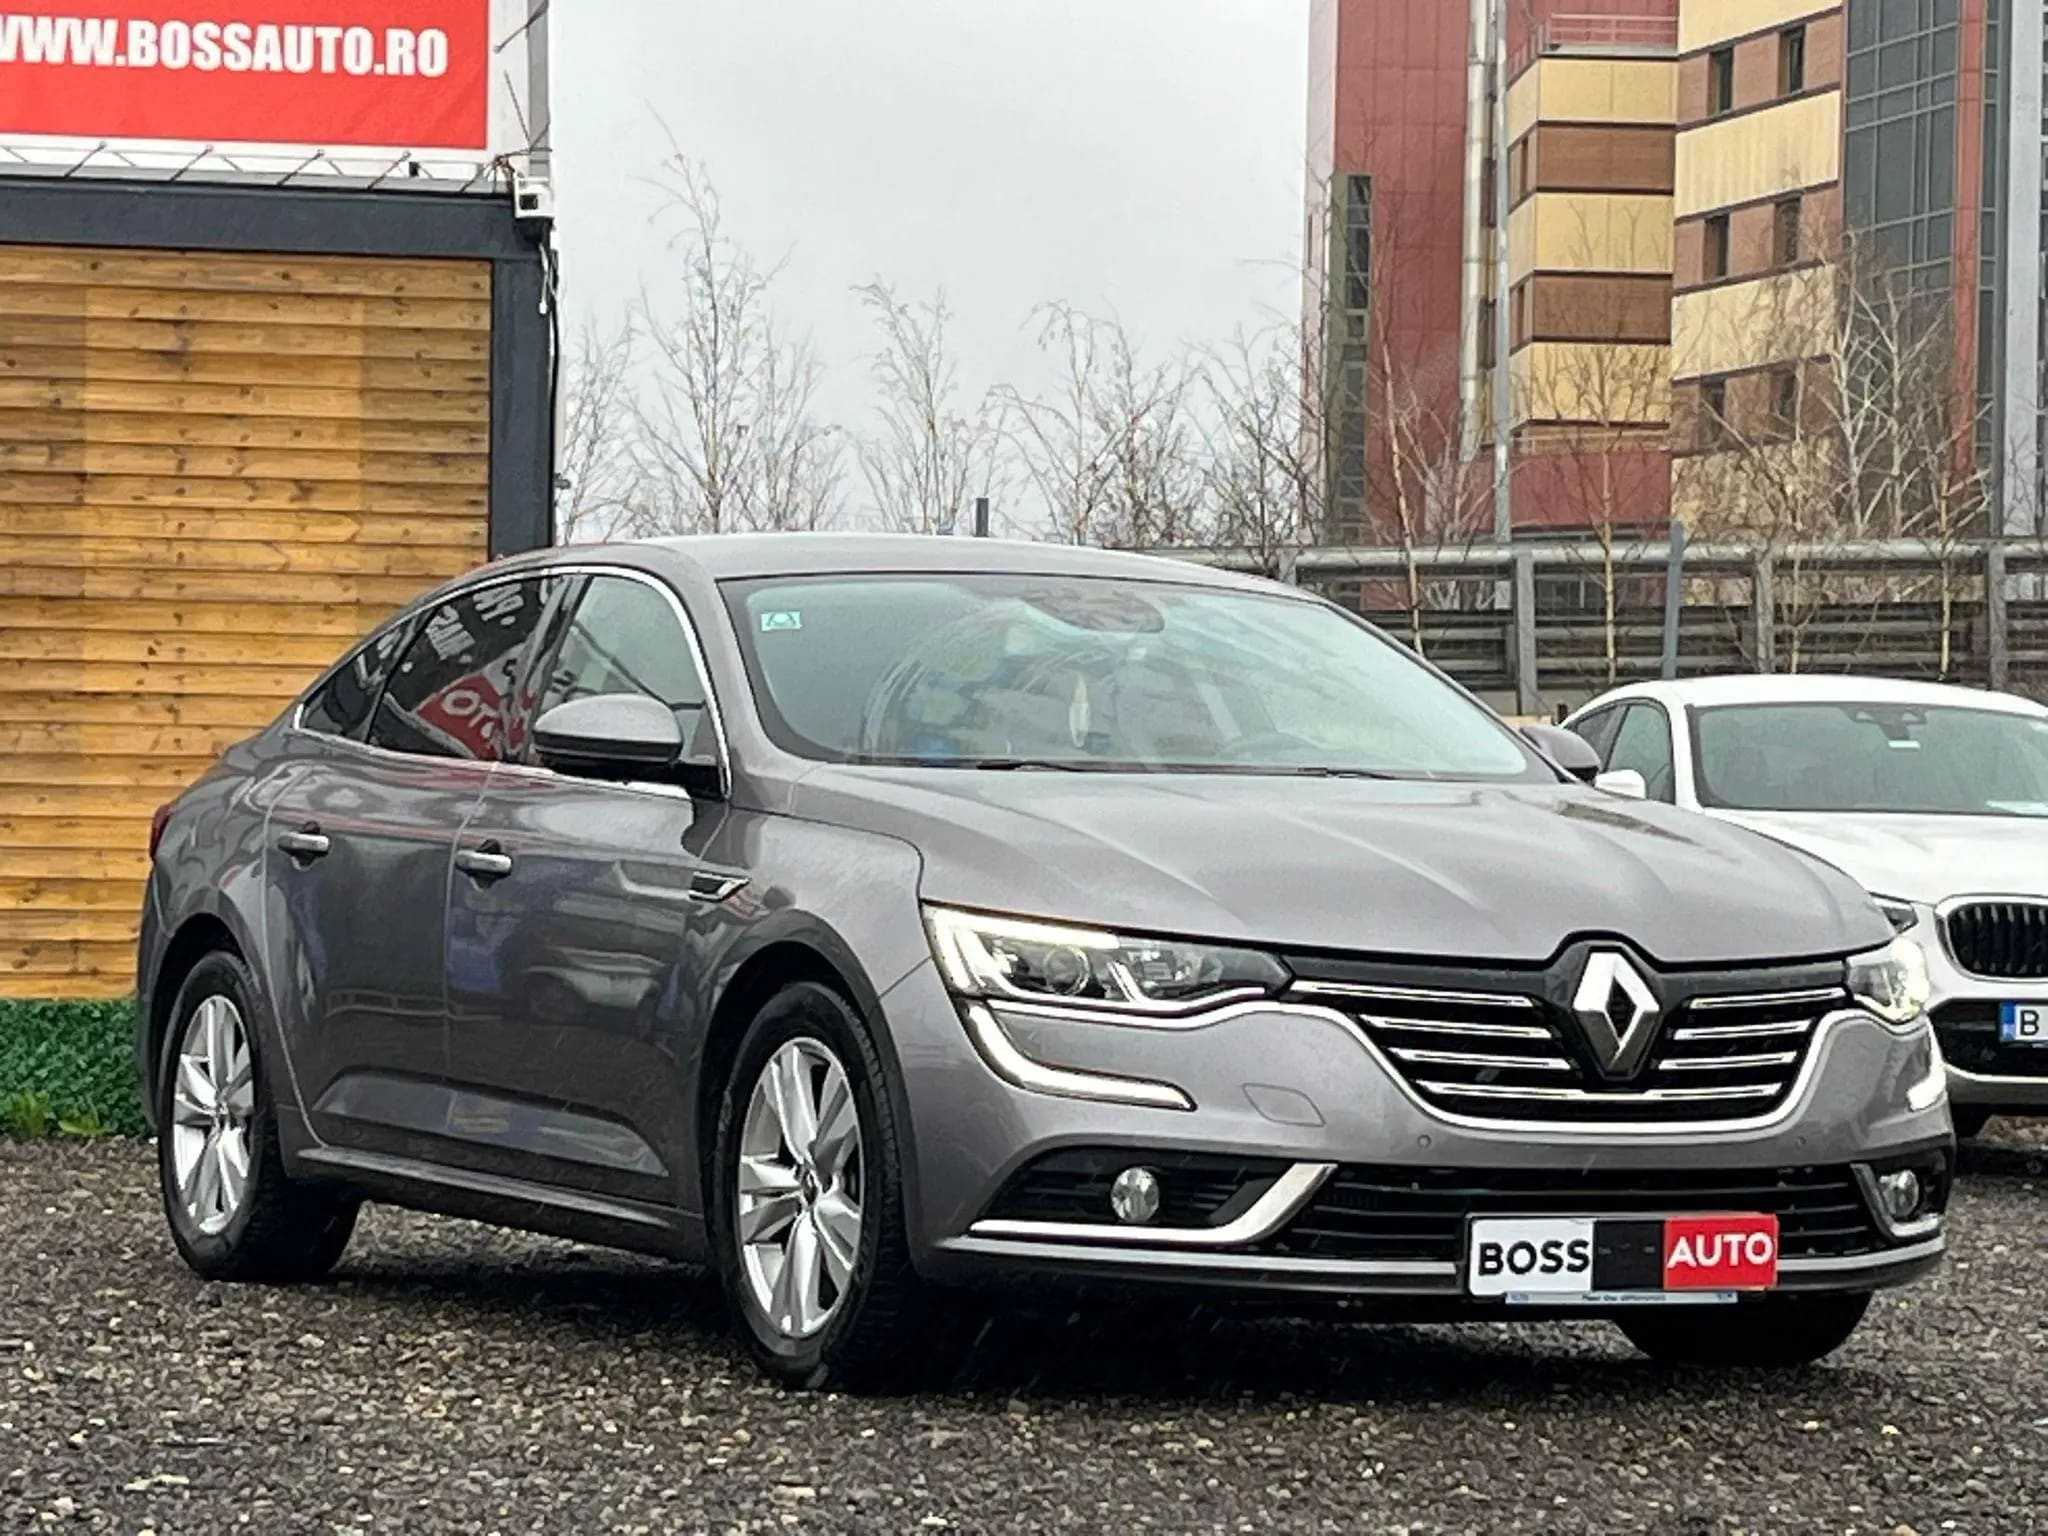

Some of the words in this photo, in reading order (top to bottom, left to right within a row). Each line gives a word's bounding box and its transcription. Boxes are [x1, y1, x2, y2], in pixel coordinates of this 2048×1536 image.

[2020, 1009, 2040, 1036] B
[1478, 1239, 1591, 1277] BOSS
[1667, 1232, 1774, 1269] AUTO
